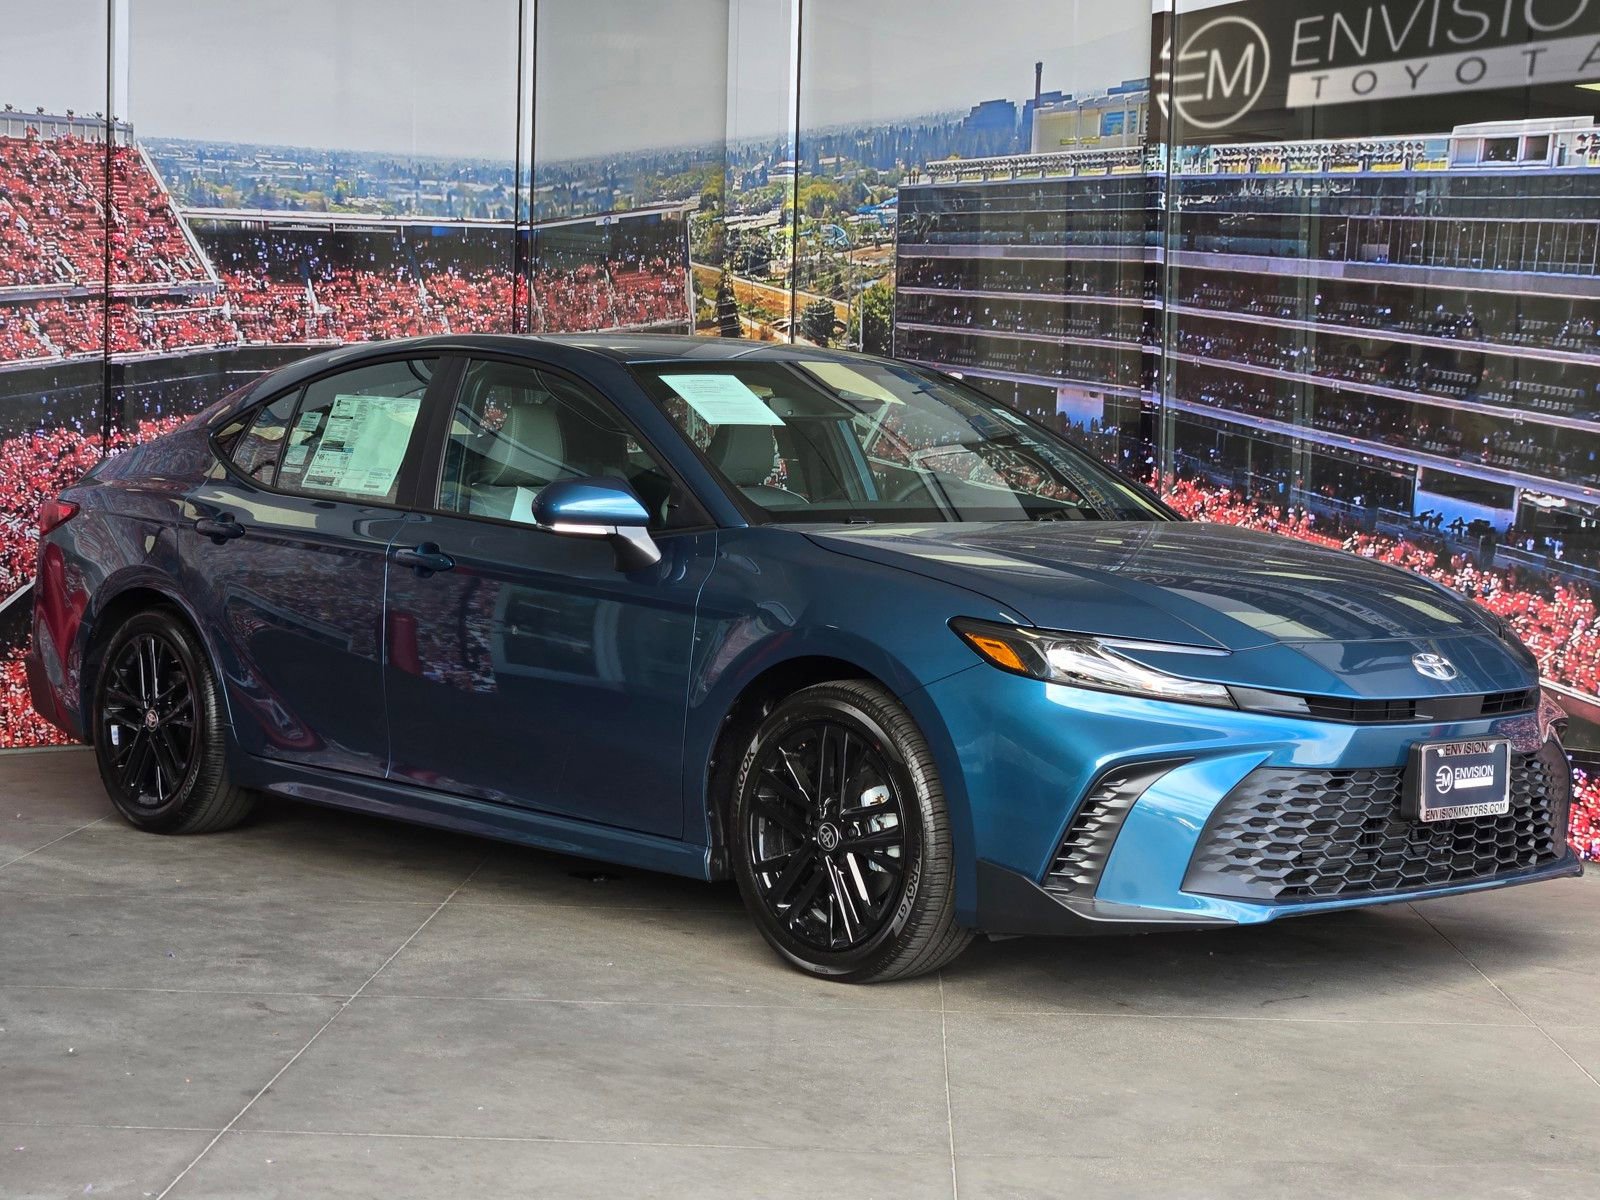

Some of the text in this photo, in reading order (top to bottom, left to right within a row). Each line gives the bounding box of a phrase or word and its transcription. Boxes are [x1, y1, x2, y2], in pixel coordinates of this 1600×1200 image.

[1446, 742, 1488, 756] ENVISION
[1454, 765, 1494, 779] ENVISION
[1426, 803, 1505, 820] ENVISIONMOTORS.COM
